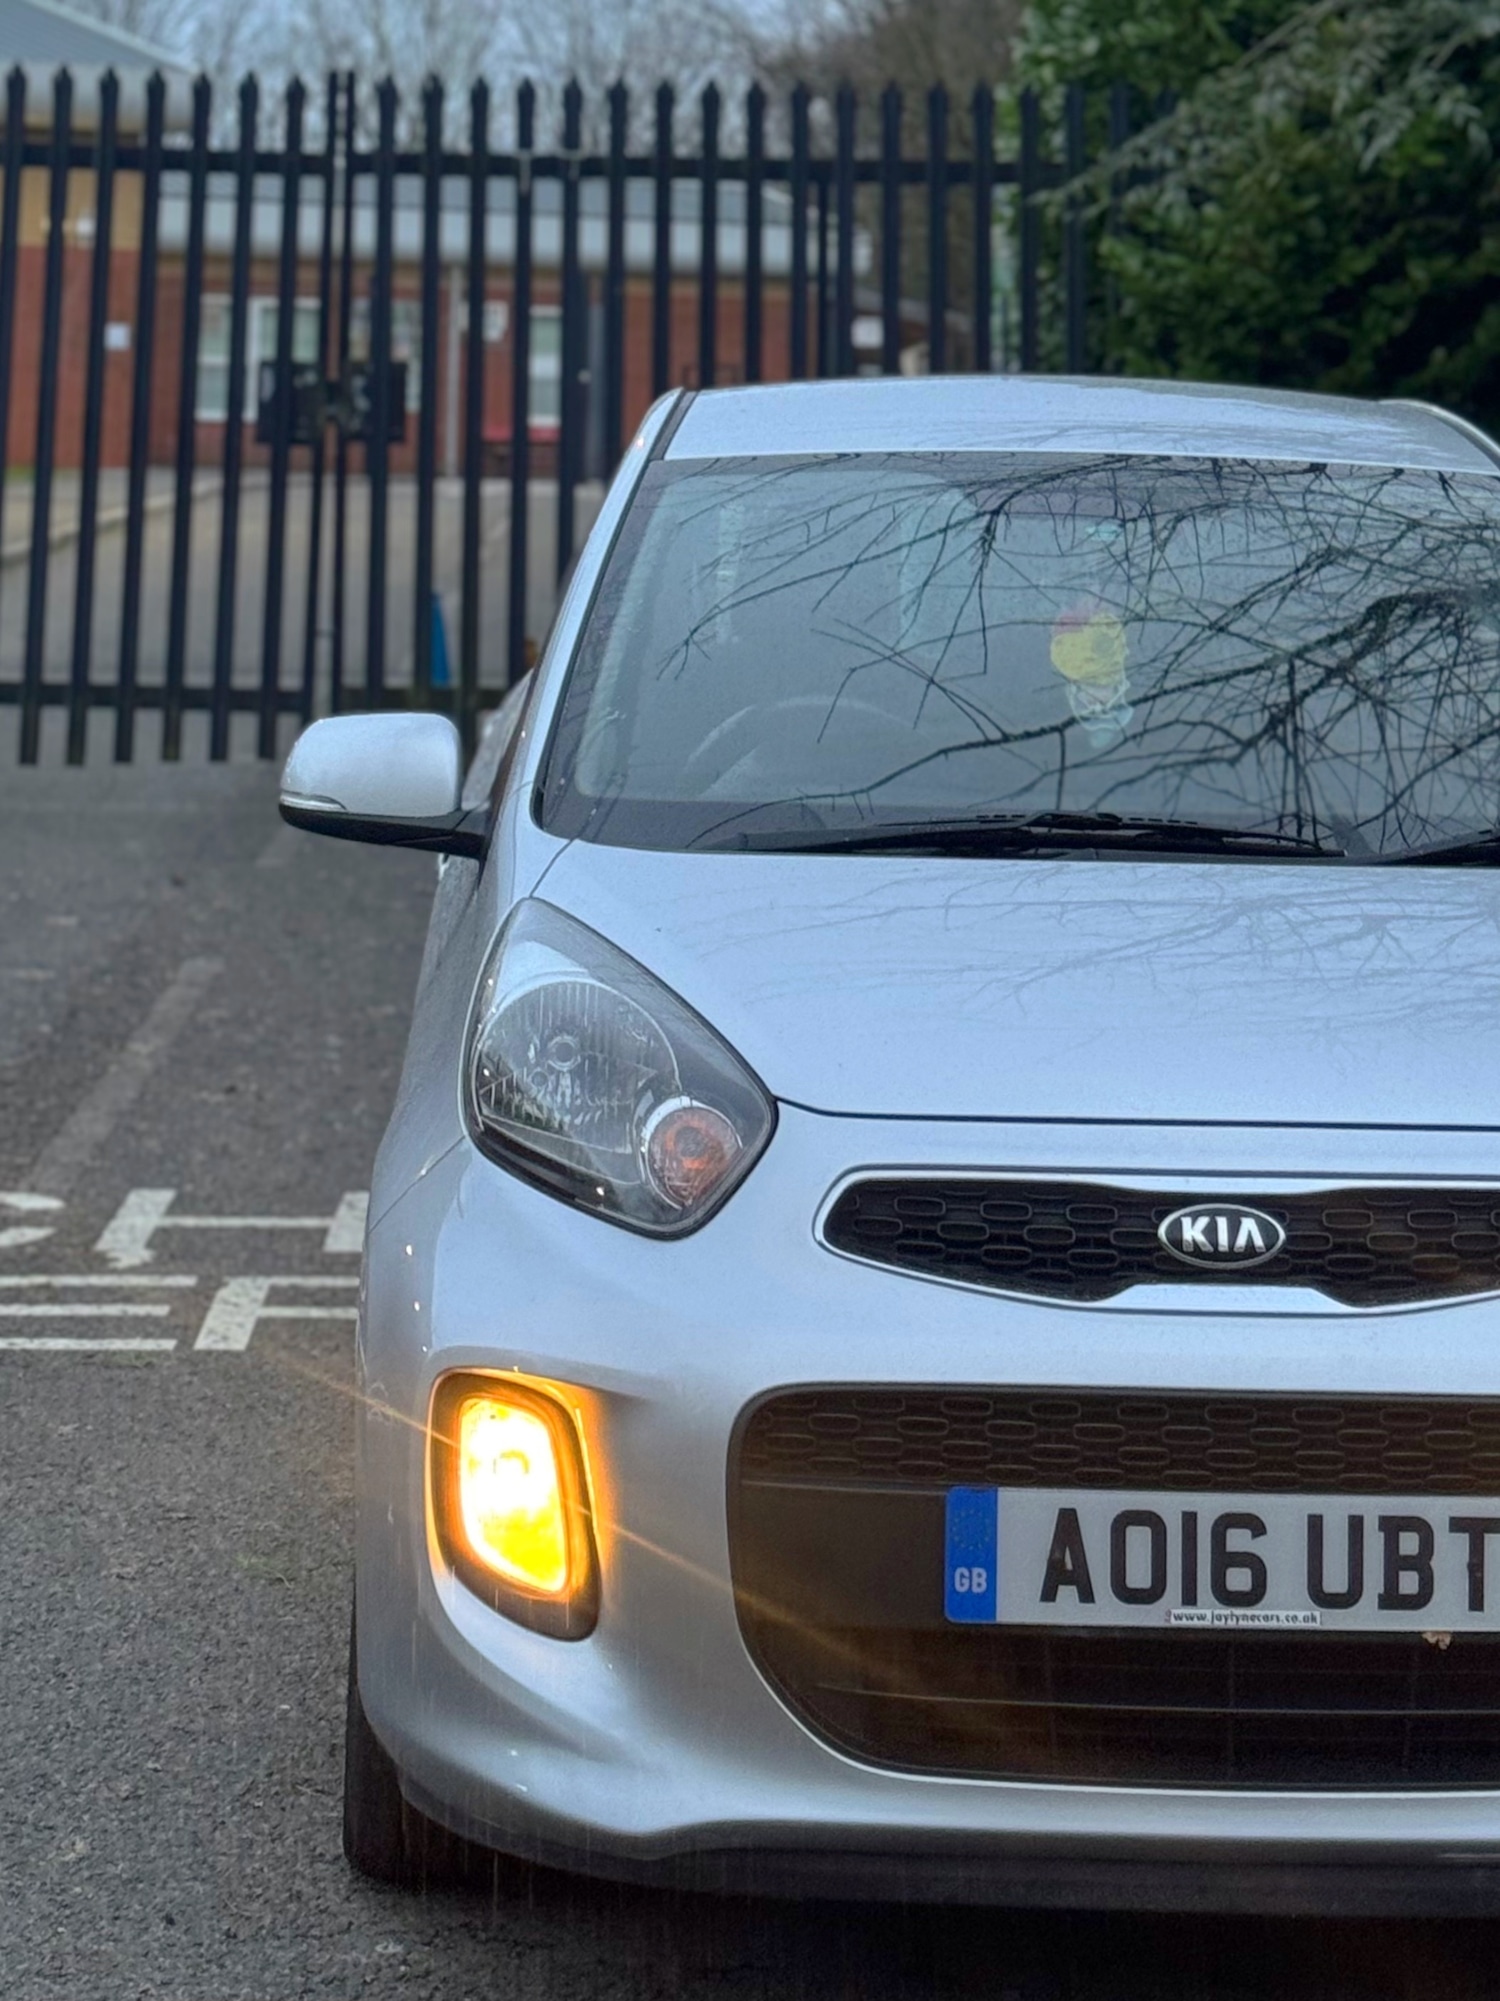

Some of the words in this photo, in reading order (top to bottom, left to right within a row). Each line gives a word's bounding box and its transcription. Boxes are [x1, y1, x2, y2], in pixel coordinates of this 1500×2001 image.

[1180, 1216, 1267, 1252] KIA
[1039, 1507, 1267, 1608] AO16
[1306, 1513, 1500, 1613] UBT
[954, 1566, 988, 1593] GB
